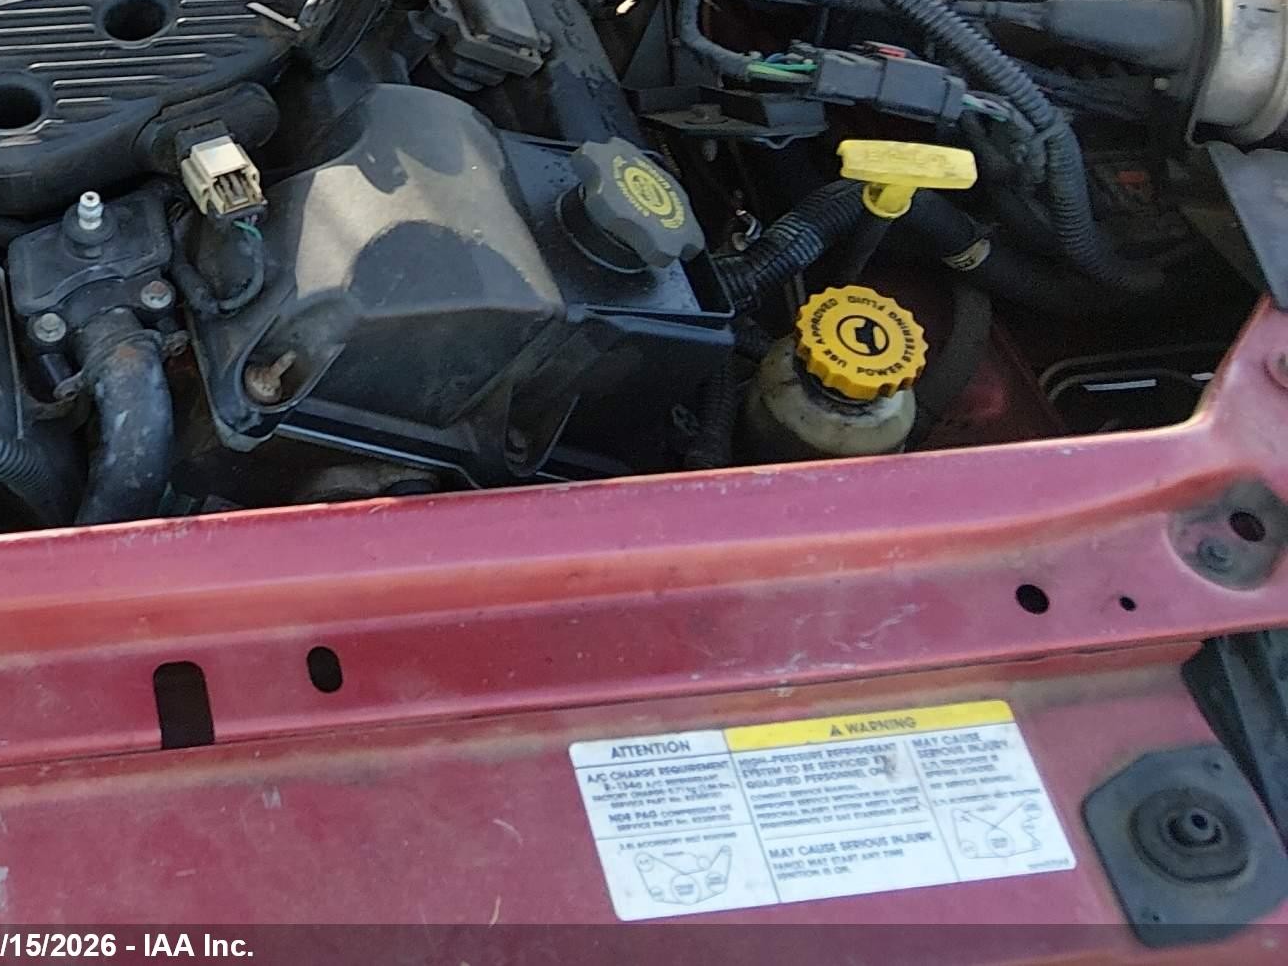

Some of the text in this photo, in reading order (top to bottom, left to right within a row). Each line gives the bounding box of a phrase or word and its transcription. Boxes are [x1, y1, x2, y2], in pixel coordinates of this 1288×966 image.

[810, 297, 848, 369] USE APPROVED
[847, 295, 916, 376] POWER STEERING FLUID
[845, 718, 916, 734] WARNING
[912, 732, 980, 746] MAY CAUSE
[610, 740, 690, 758] ATTENTION
[918, 746, 965, 757] SERIOUS
[587, 761, 730, 782] A/C CHARGE REQUIREMENT
[785, 765, 799, 773] TO
[803, 763, 815, 771] BE
[769, 848, 794, 858] MAY
[798, 843, 836, 854] CAUSE
[840, 838, 889, 850] SERIOUS
